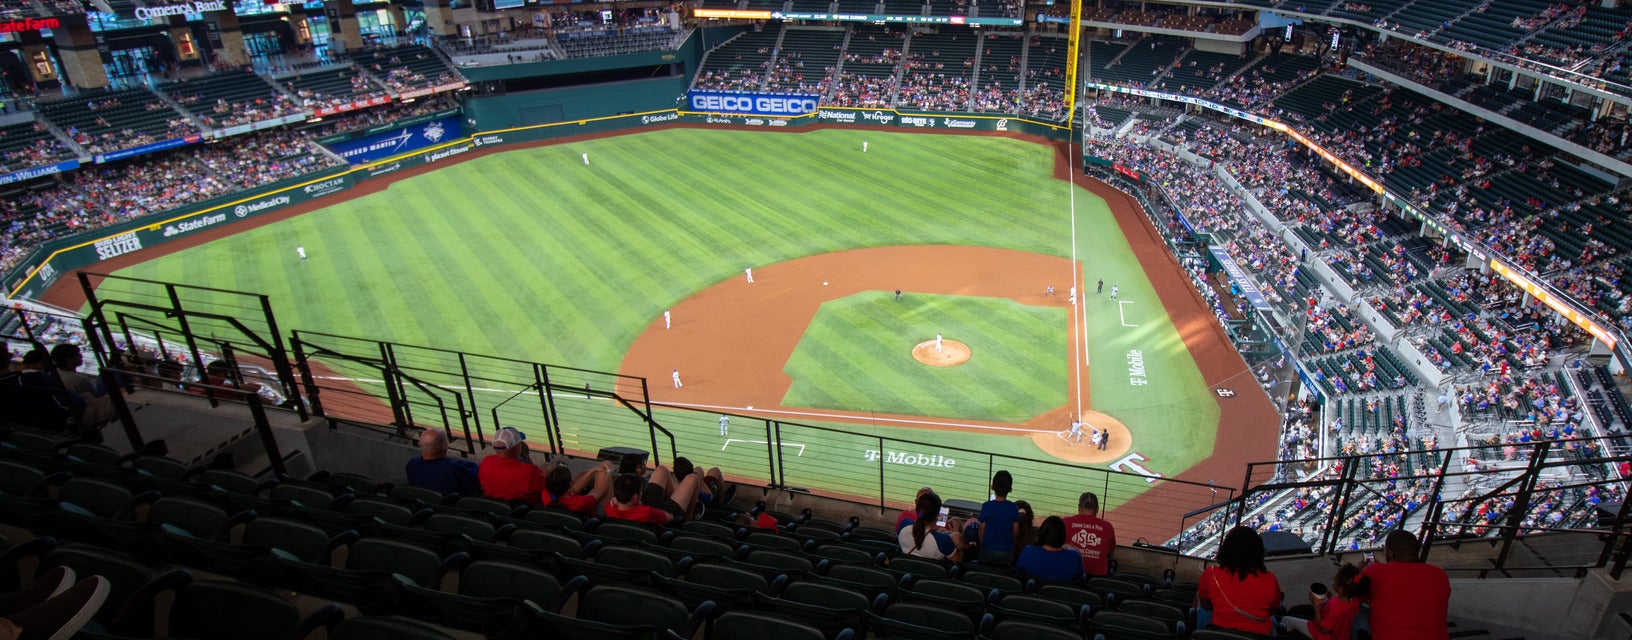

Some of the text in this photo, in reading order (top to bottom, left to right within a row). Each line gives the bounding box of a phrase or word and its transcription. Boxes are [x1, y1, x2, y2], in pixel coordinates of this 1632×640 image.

[195, 0, 227, 12] Bank
[0, 18, 59, 34] ateFarm
[693, 95, 816, 113] GEICO GEICO
[668, 113, 678, 121] Life
[826, 111, 855, 119] National
[872, 111, 894, 124] Kroger
[340, 140, 396, 157] CKHEED MARTIN
[431, 151, 450, 162] planet
[97, 237, 143, 260] SELTZER
[1127, 349, 1146, 377] Mobile
[886, 451, 956, 468] Mobile
